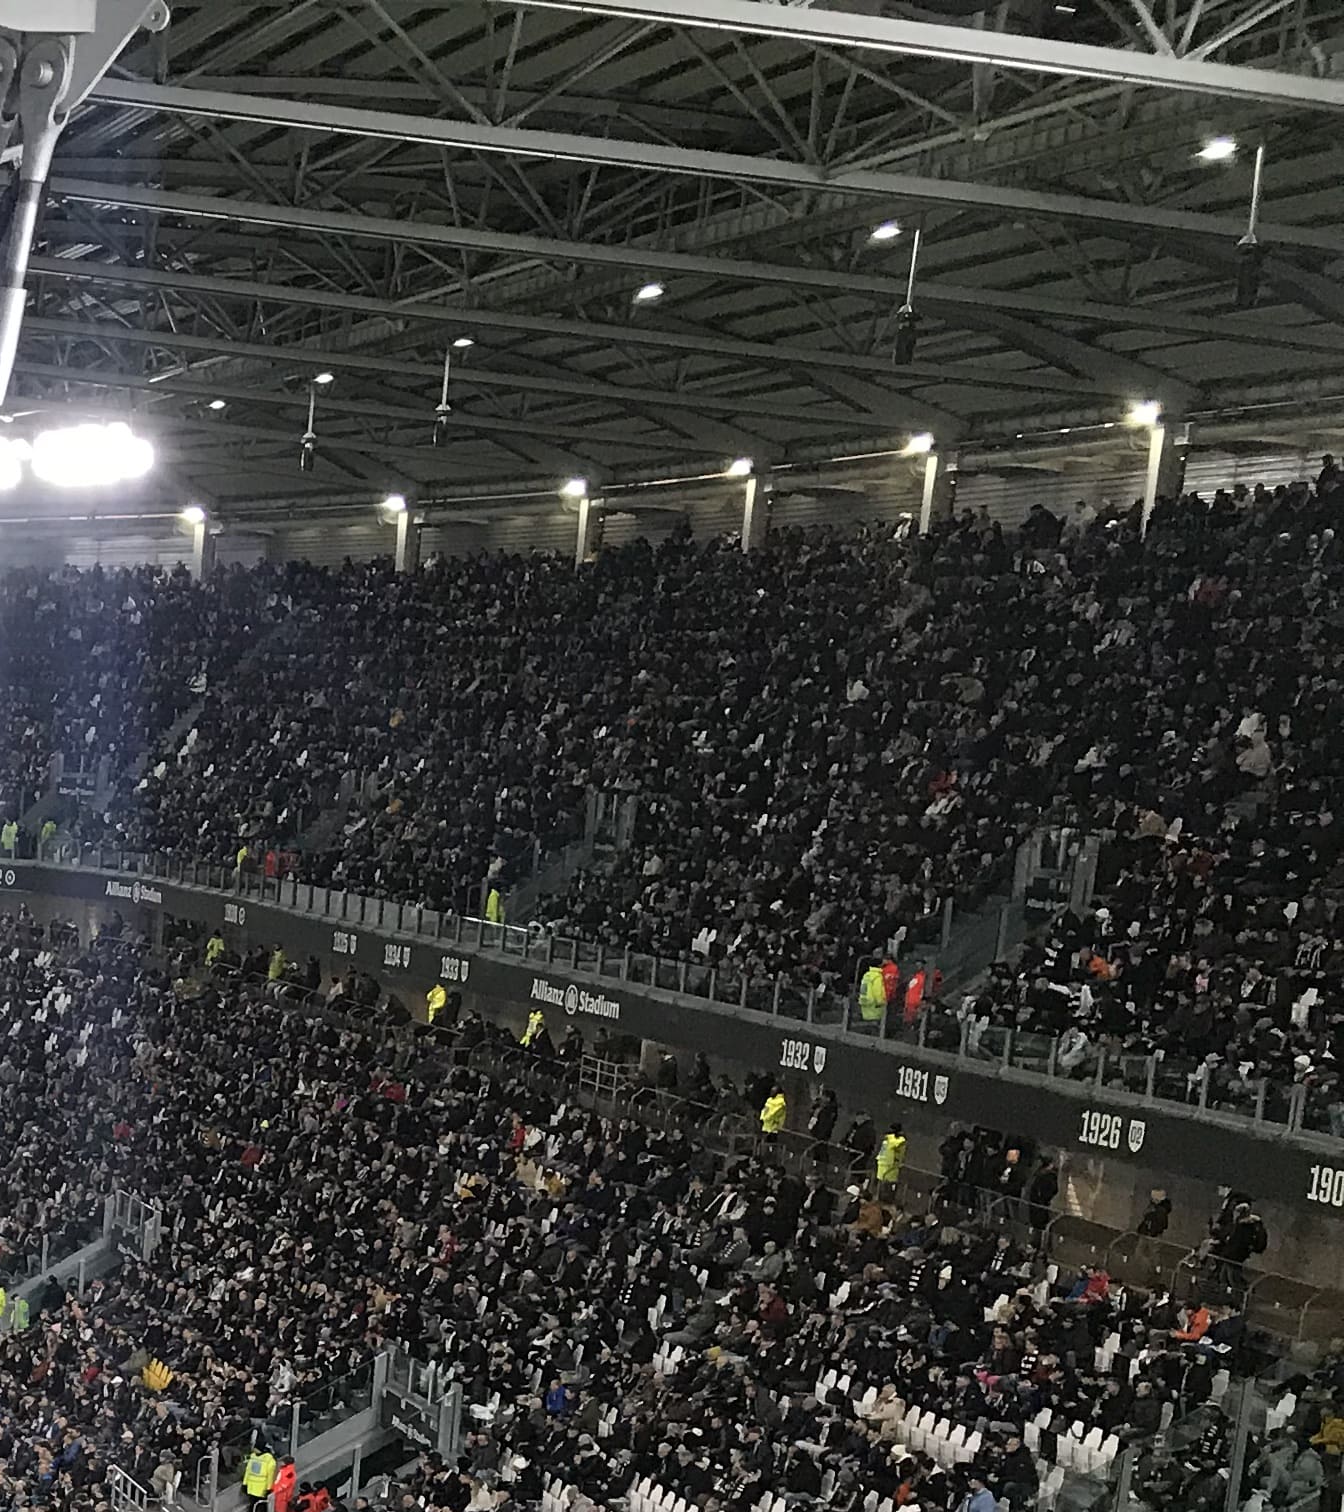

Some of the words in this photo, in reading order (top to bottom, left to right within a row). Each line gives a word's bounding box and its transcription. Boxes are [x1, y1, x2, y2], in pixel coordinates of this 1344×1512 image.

[105, 880, 132, 898] Allianz
[530, 978, 565, 1006] Allianz
[578, 990, 620, 1019] Stadium
[780, 1039, 809, 1070] 1932
[896, 1066, 928, 1101] 1931
[1079, 1111, 1121, 1148] 1926
